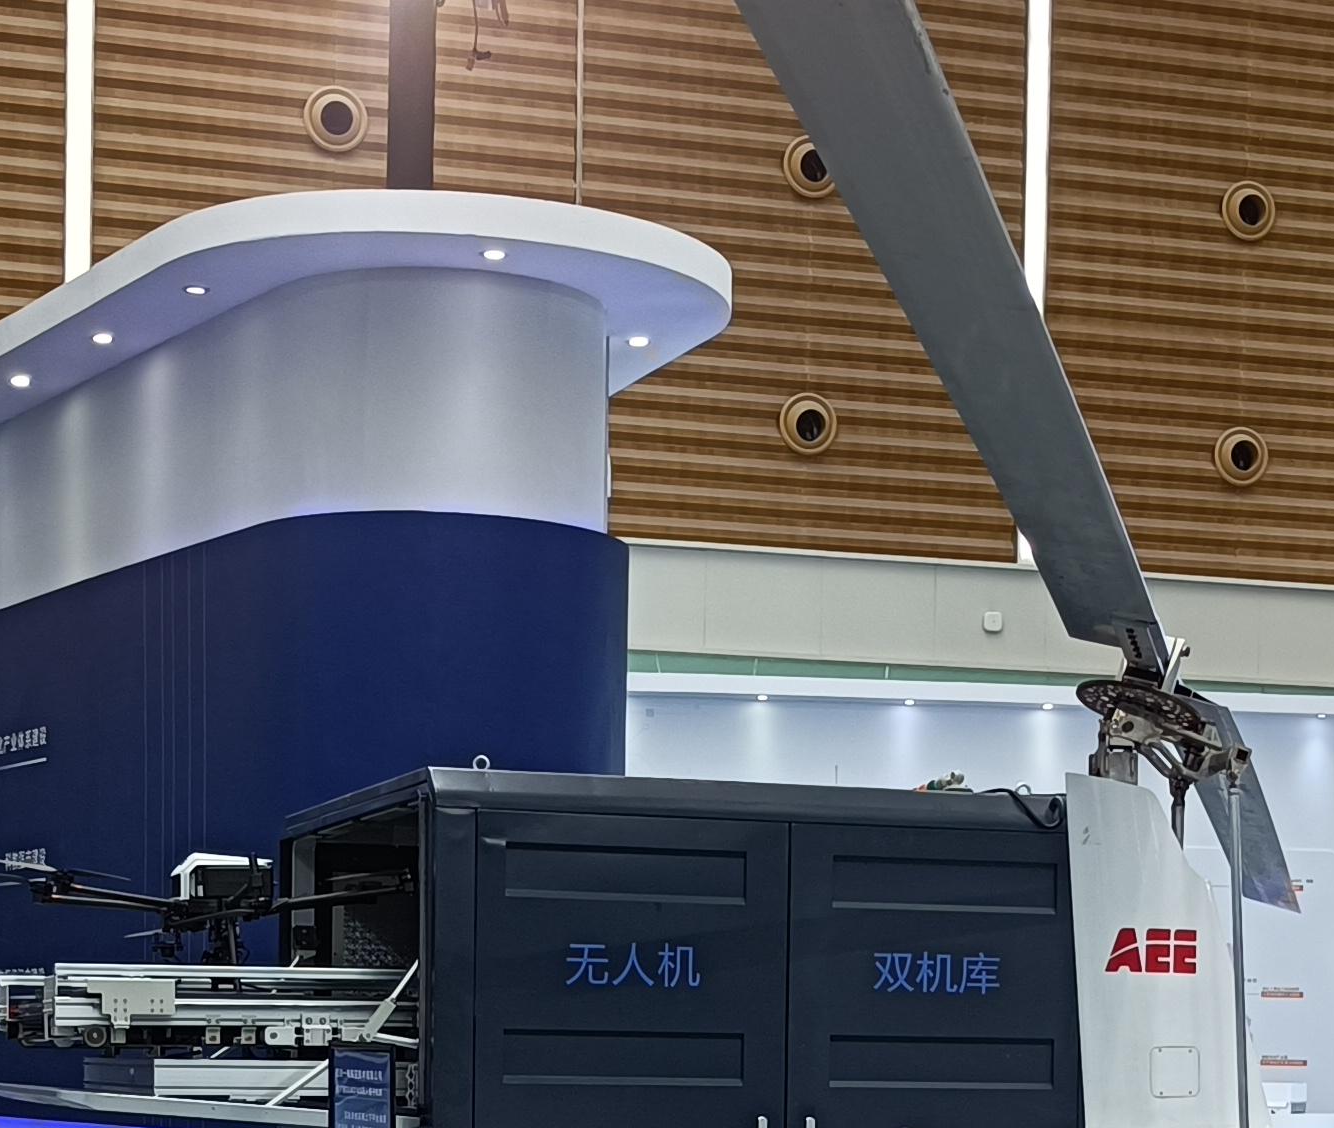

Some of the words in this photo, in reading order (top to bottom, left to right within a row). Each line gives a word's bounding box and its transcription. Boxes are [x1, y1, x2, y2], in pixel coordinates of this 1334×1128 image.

[565, 942, 701, 989] 无人机
[872, 951, 1002, 995] 双机库
[1104, 927, 1197, 974] AEE
